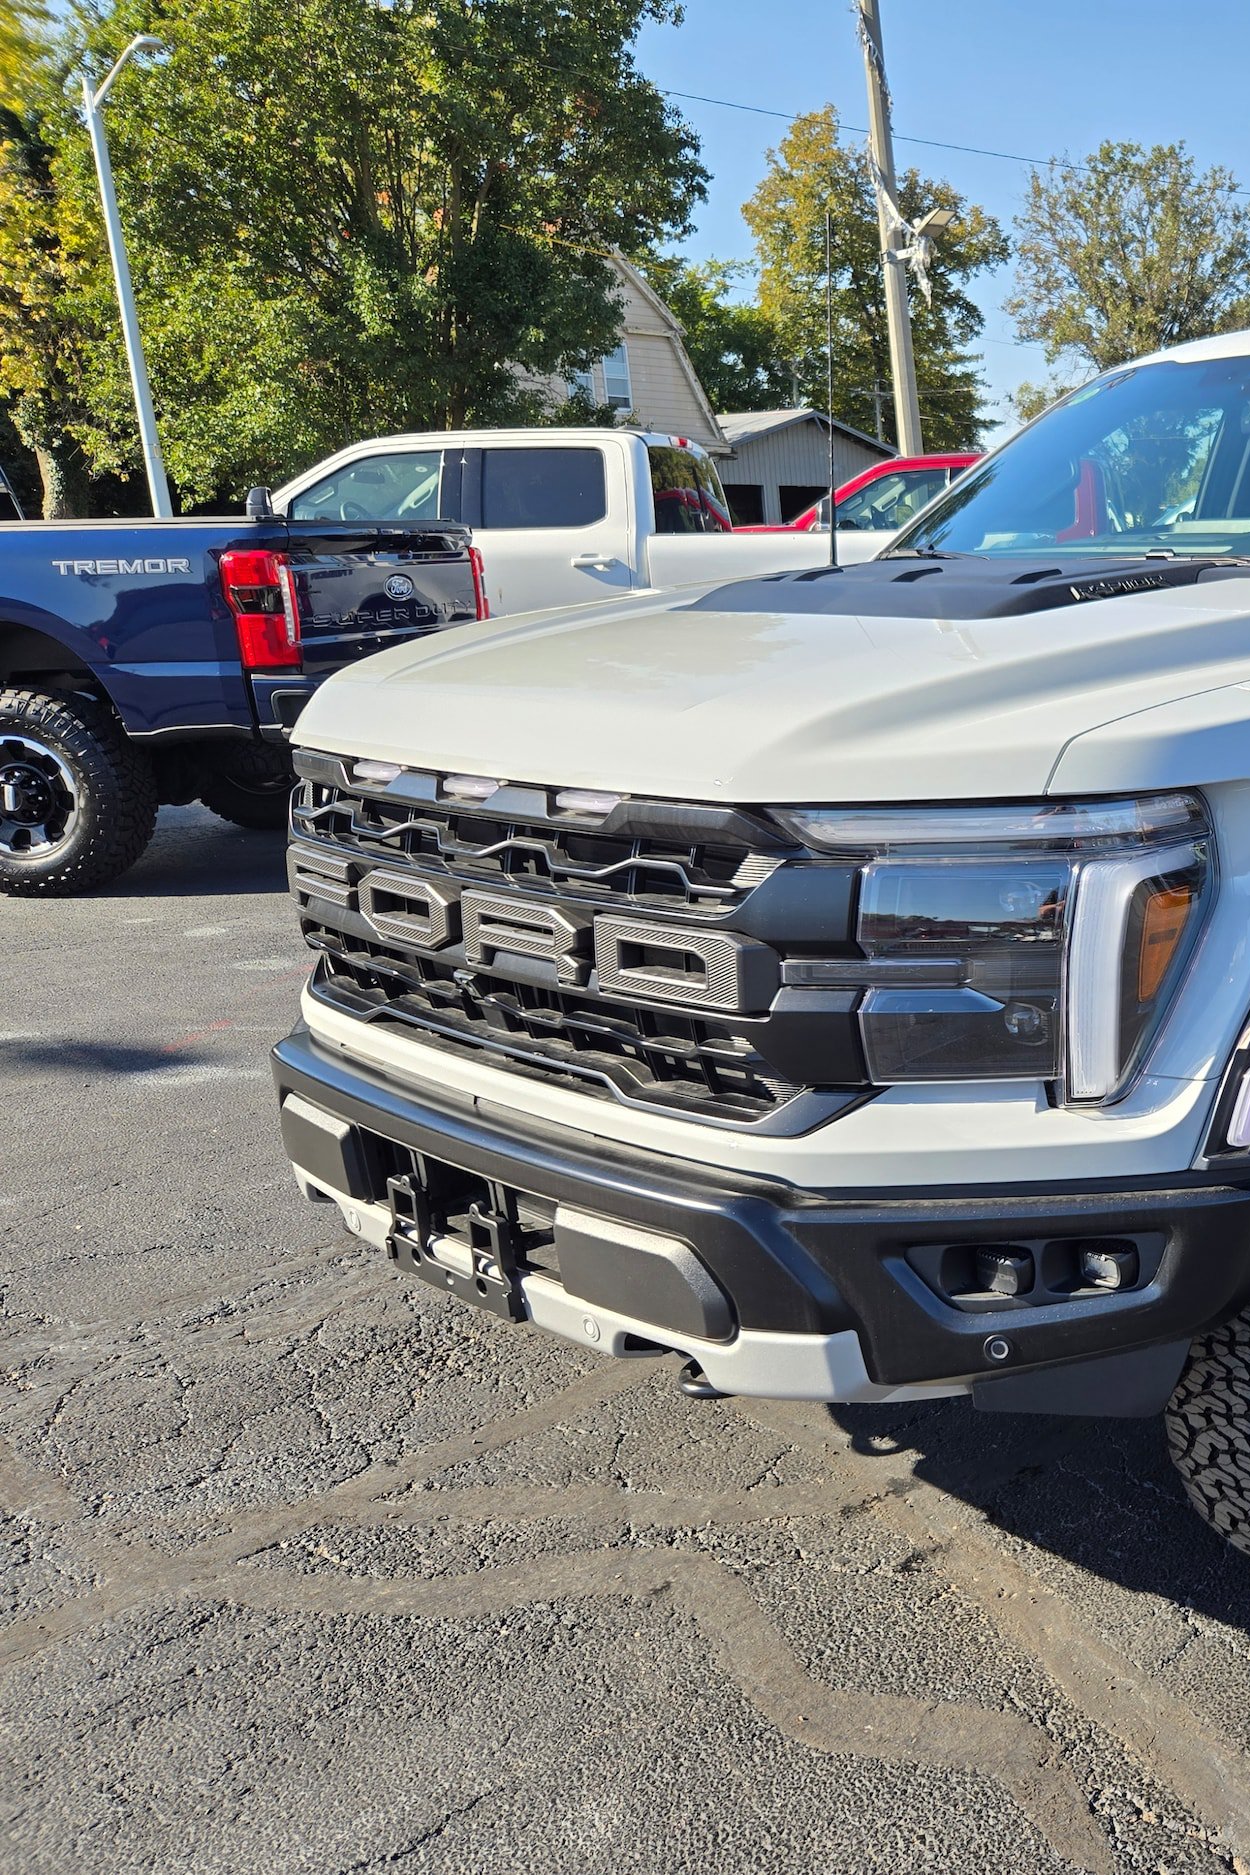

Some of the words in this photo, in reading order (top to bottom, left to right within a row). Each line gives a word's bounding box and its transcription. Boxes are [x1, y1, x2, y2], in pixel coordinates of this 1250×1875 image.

[51, 557, 192, 576] TREMOR
[312, 608, 411, 628] SUPER
[415, 599, 472, 618] DUTY
[287, 843, 746, 1011] FORD
